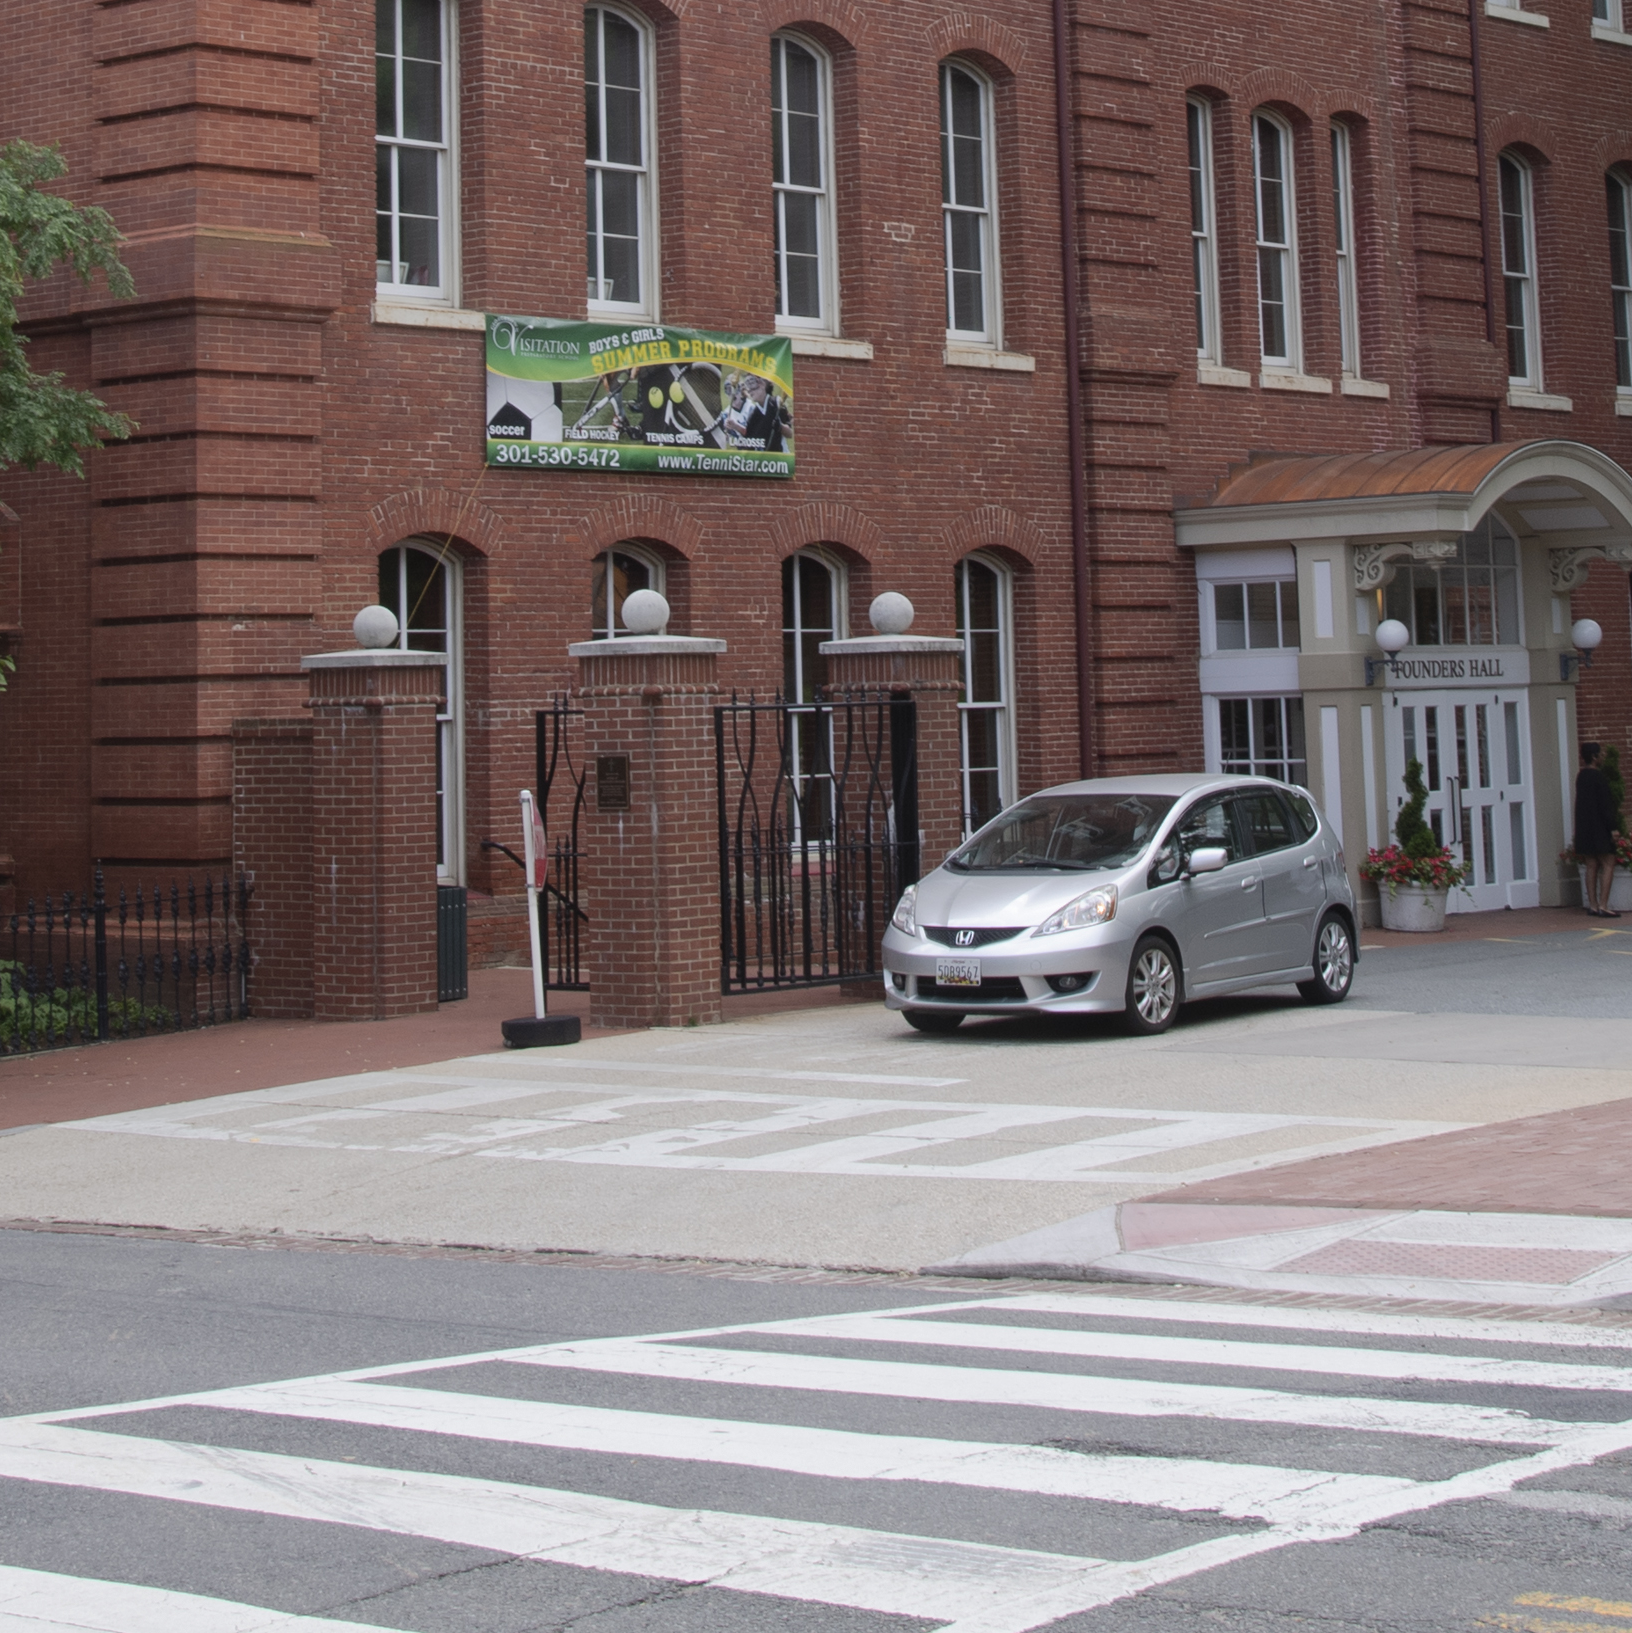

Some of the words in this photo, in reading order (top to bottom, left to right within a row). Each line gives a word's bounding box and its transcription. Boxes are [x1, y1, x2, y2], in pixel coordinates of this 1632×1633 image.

[493, 321, 580, 356] VISITATION
[588, 335, 619, 354] BOYS
[630, 328, 665, 344] GIRLS
[591, 341, 672, 374] SUMMER
[678, 339, 778, 374] PROGRAMS
[489, 425, 525, 436] soccer
[565, 429, 588, 440] FIELD
[590, 430, 620, 441] HOCKEY
[645, 432, 675, 444] TENNIS
[675, 433, 705, 445] CAMPS
[729, 436, 766, 448] LACROSSE
[496, 444, 620, 467] 301-530-5472
[658, 454, 789, 474] www.TenniStar.com
[1395, 659, 1465, 679] FOUNDERS
[1469, 658, 1504, 677] HALL
